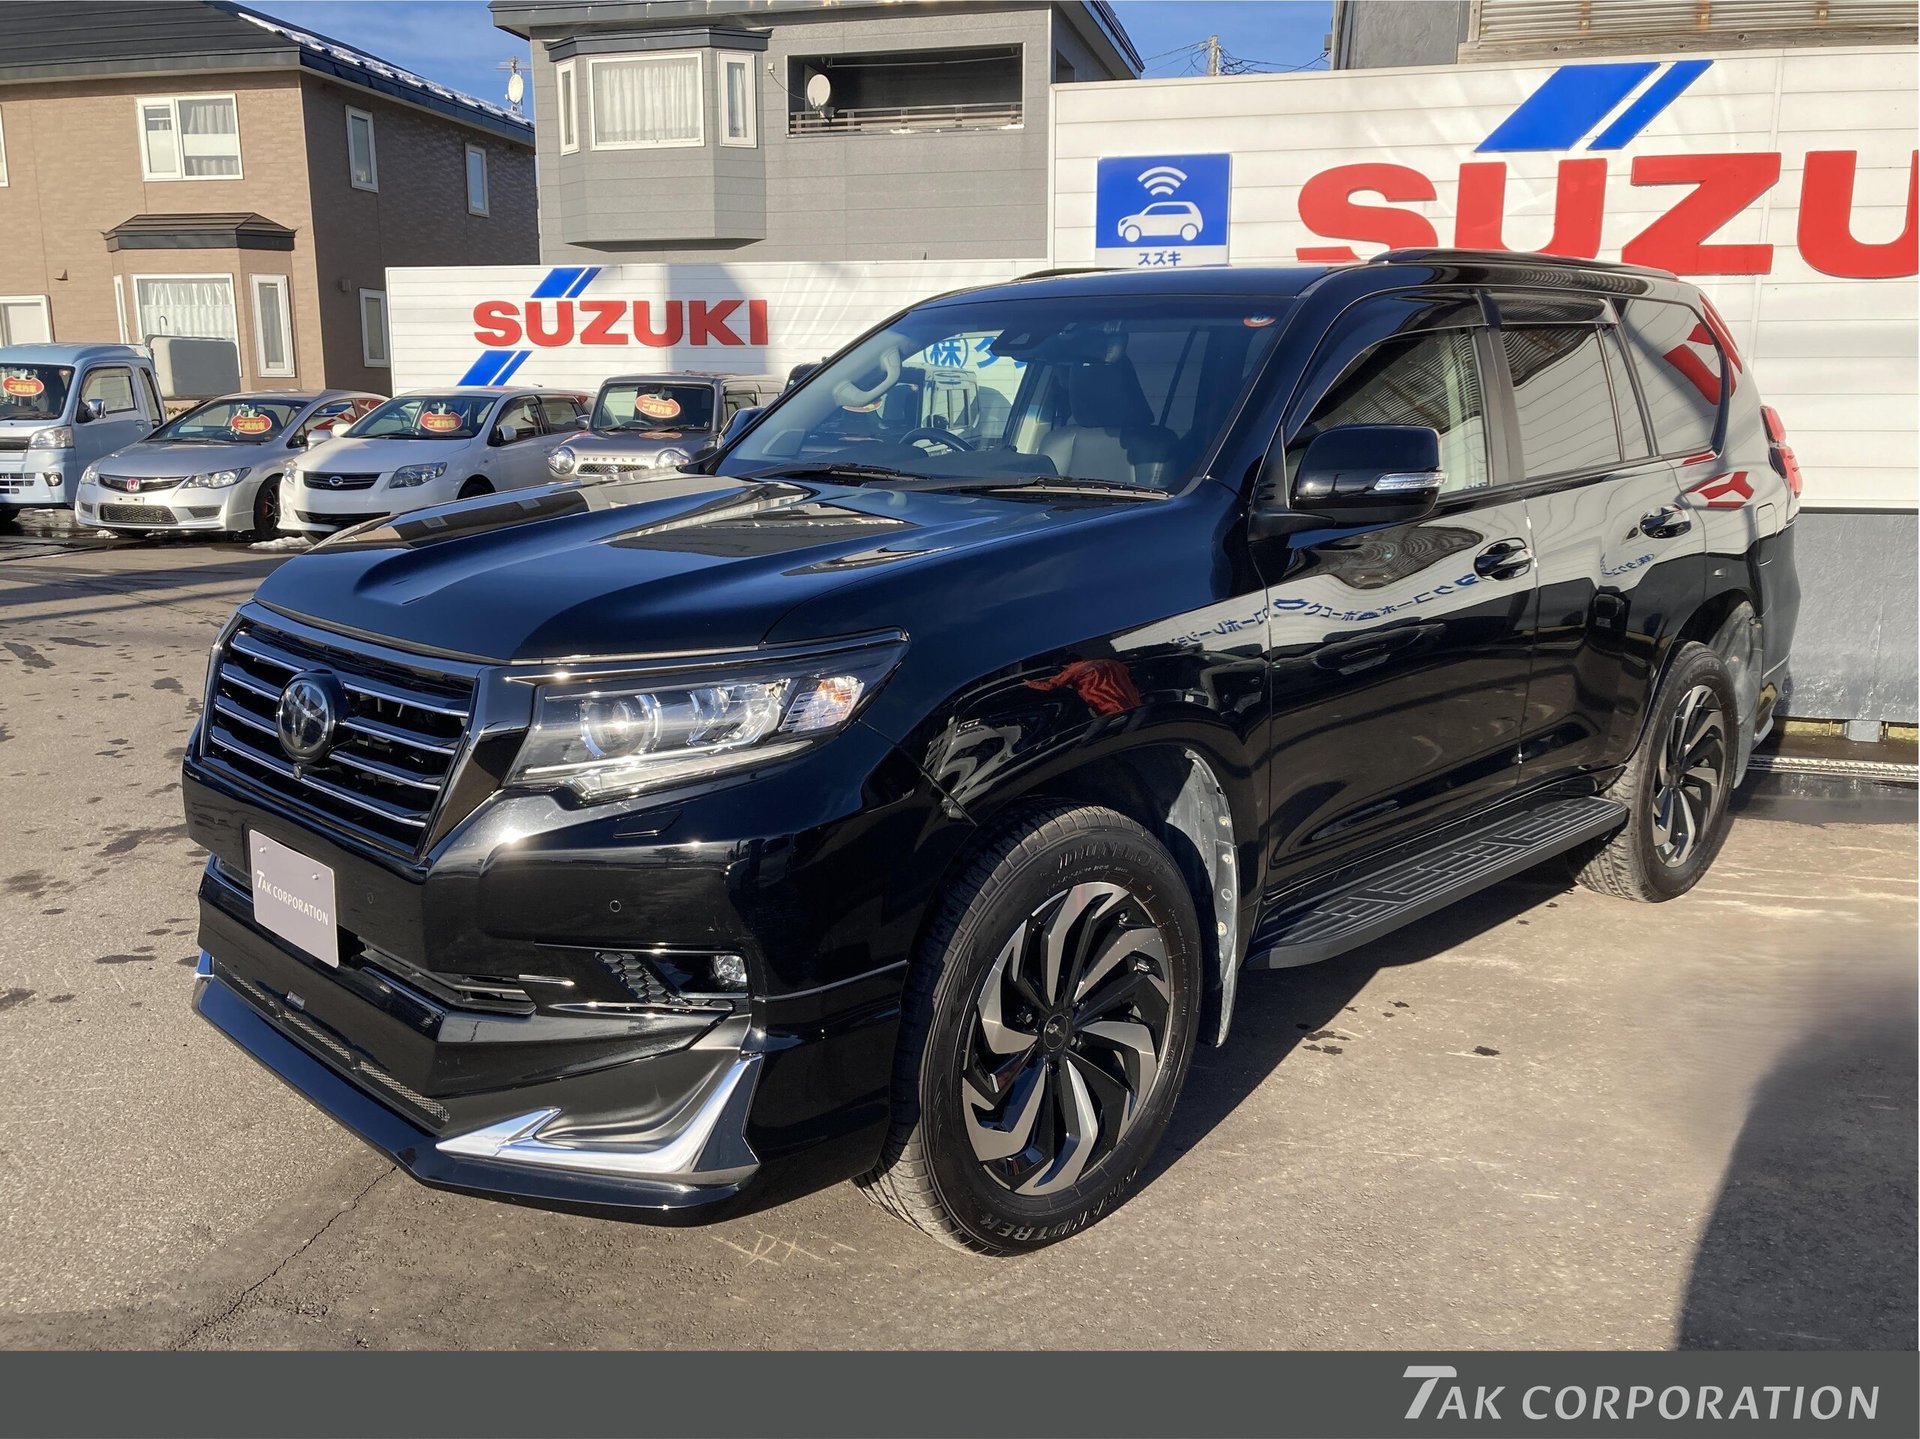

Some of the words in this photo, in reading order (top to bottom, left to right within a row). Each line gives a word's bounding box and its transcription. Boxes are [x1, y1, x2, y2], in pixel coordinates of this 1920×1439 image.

[1138, 250, 1181, 266] スズキ
[473, 300, 768, 347] SUZUKI
[256, 869, 272, 895] TAK
[273, 886, 329, 926] CORPORATION
